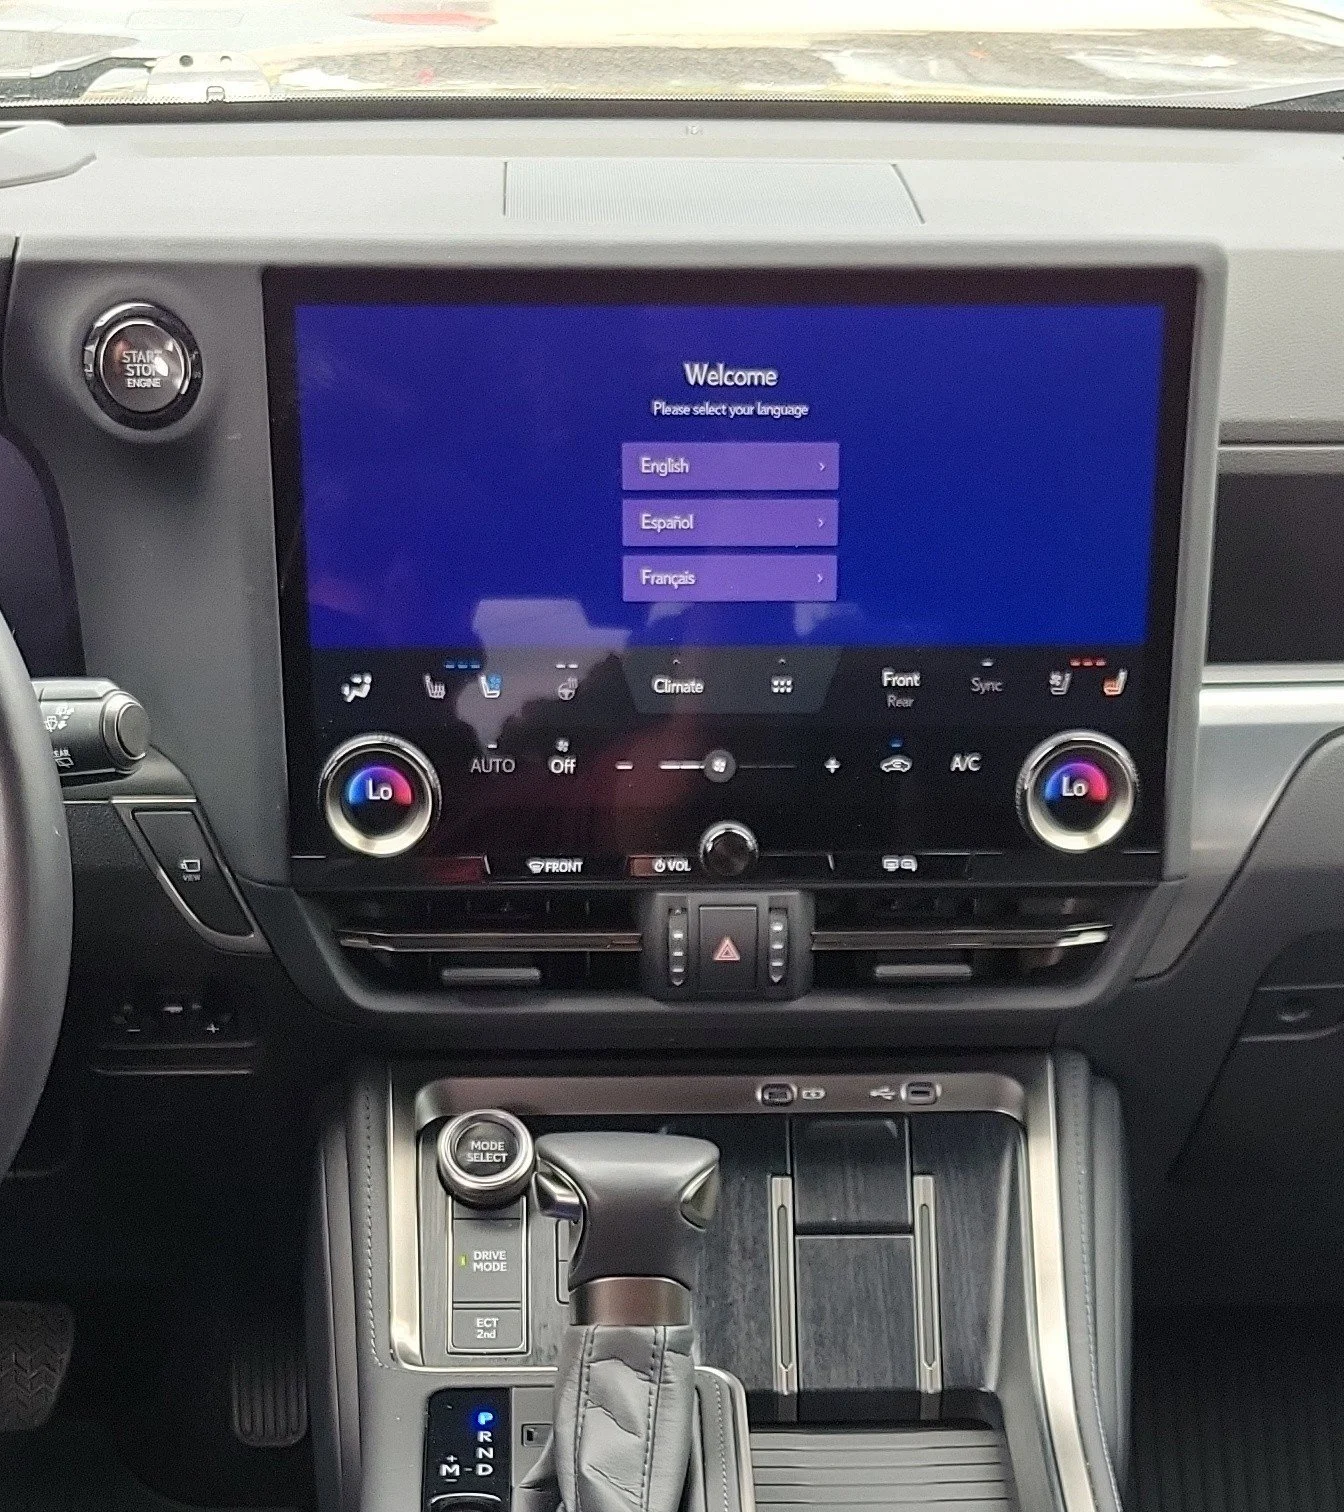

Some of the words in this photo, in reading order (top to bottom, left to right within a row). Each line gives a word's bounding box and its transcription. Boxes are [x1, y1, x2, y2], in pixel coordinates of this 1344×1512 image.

[682, 361, 779, 387] Welcome
[126, 378, 161, 388] ENGINE
[652, 401, 691, 416] Please
[692, 402, 727, 416] select
[729, 405, 754, 419] your
[756, 402, 809, 419] language
[640, 457, 689, 476] English
[640, 513, 694, 533] Español
[640, 569, 696, 589] Français
[881, 668, 921, 688] Front
[652, 678, 705, 694] Climate
[970, 677, 1003, 695] Sync
[886, 694, 915, 709] Rear
[469, 758, 516, 774] AUTO
[549, 757, 577, 775] Off
[950, 753, 981, 772] A/C
[366, 778, 393, 801] Lo
[1061, 775, 1089, 798] Lo
[544, 859, 583, 873] FRONT
[667, 858, 692, 872] VOL
[470, 1140, 505, 1151] MODE
[466, 1152, 508, 1163] SELECT
[473, 1250, 507, 1261] DRIVE
[473, 1262, 508, 1272] MODE
[475, 1317, 499, 1328] ECT
[476, 1329, 497, 1340] 2nd
[477, 1411, 494, 1426] P
[477, 1430, 493, 1443] R
[476, 1446, 494, 1459] N
[439, 1463, 460, 1477] M
[476, 1463, 494, 1476] D
